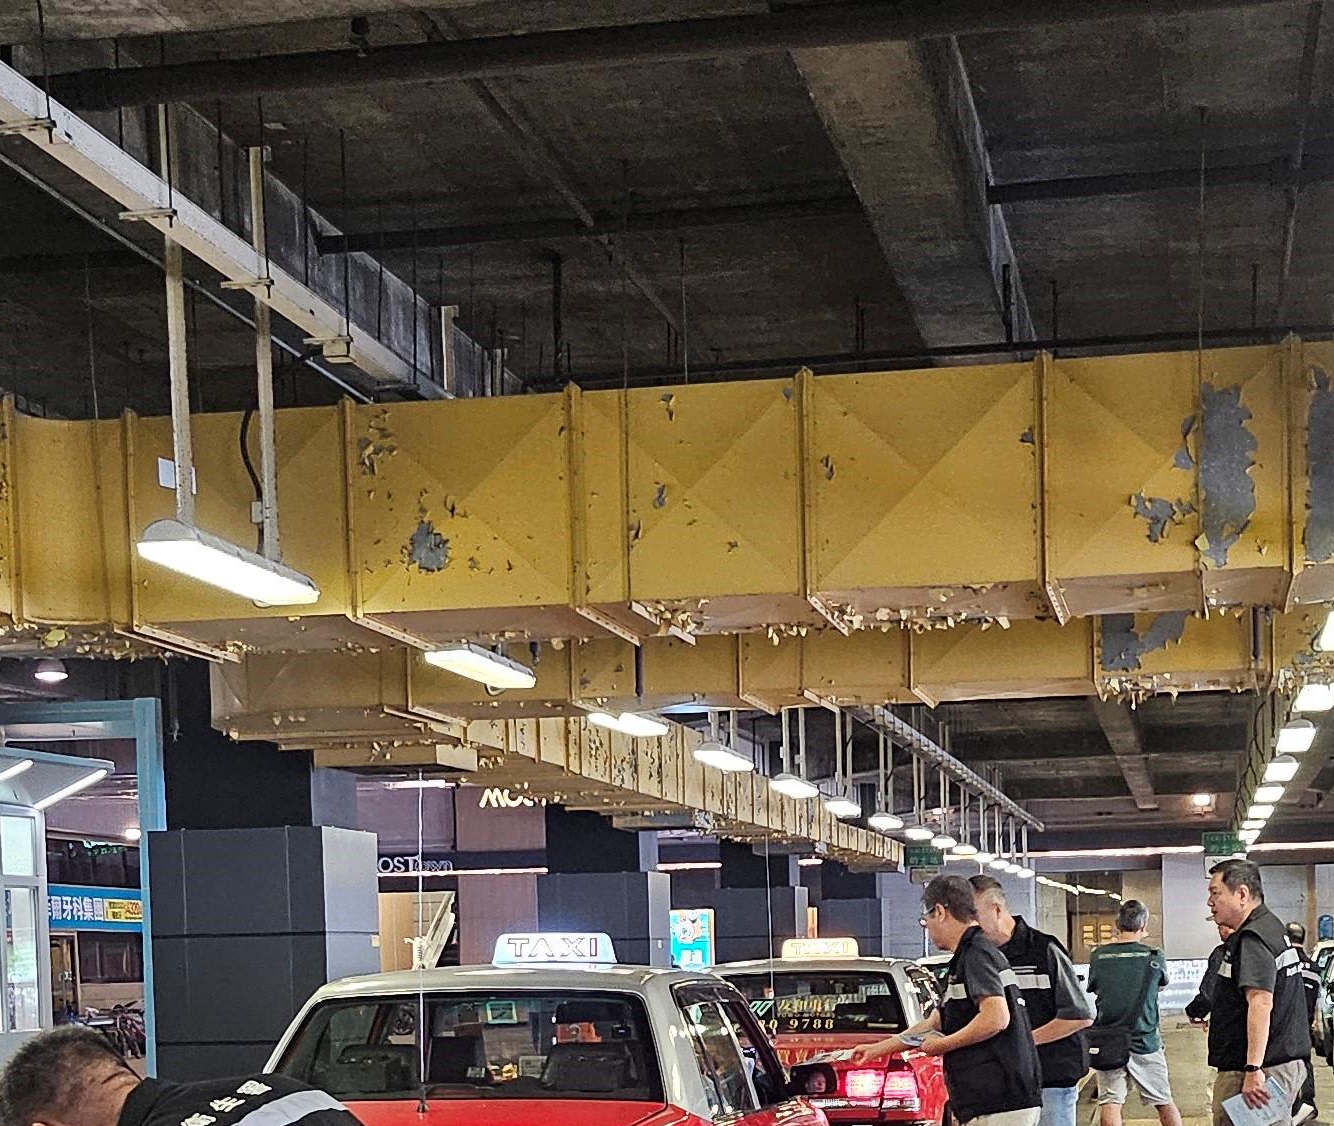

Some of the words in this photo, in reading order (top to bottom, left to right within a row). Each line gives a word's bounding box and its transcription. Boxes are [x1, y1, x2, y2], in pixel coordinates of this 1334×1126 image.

[507, 937, 598, 958] TAXI
[790, 942, 850, 956] TAXI
[789, 1018, 834, 1030] 9788
